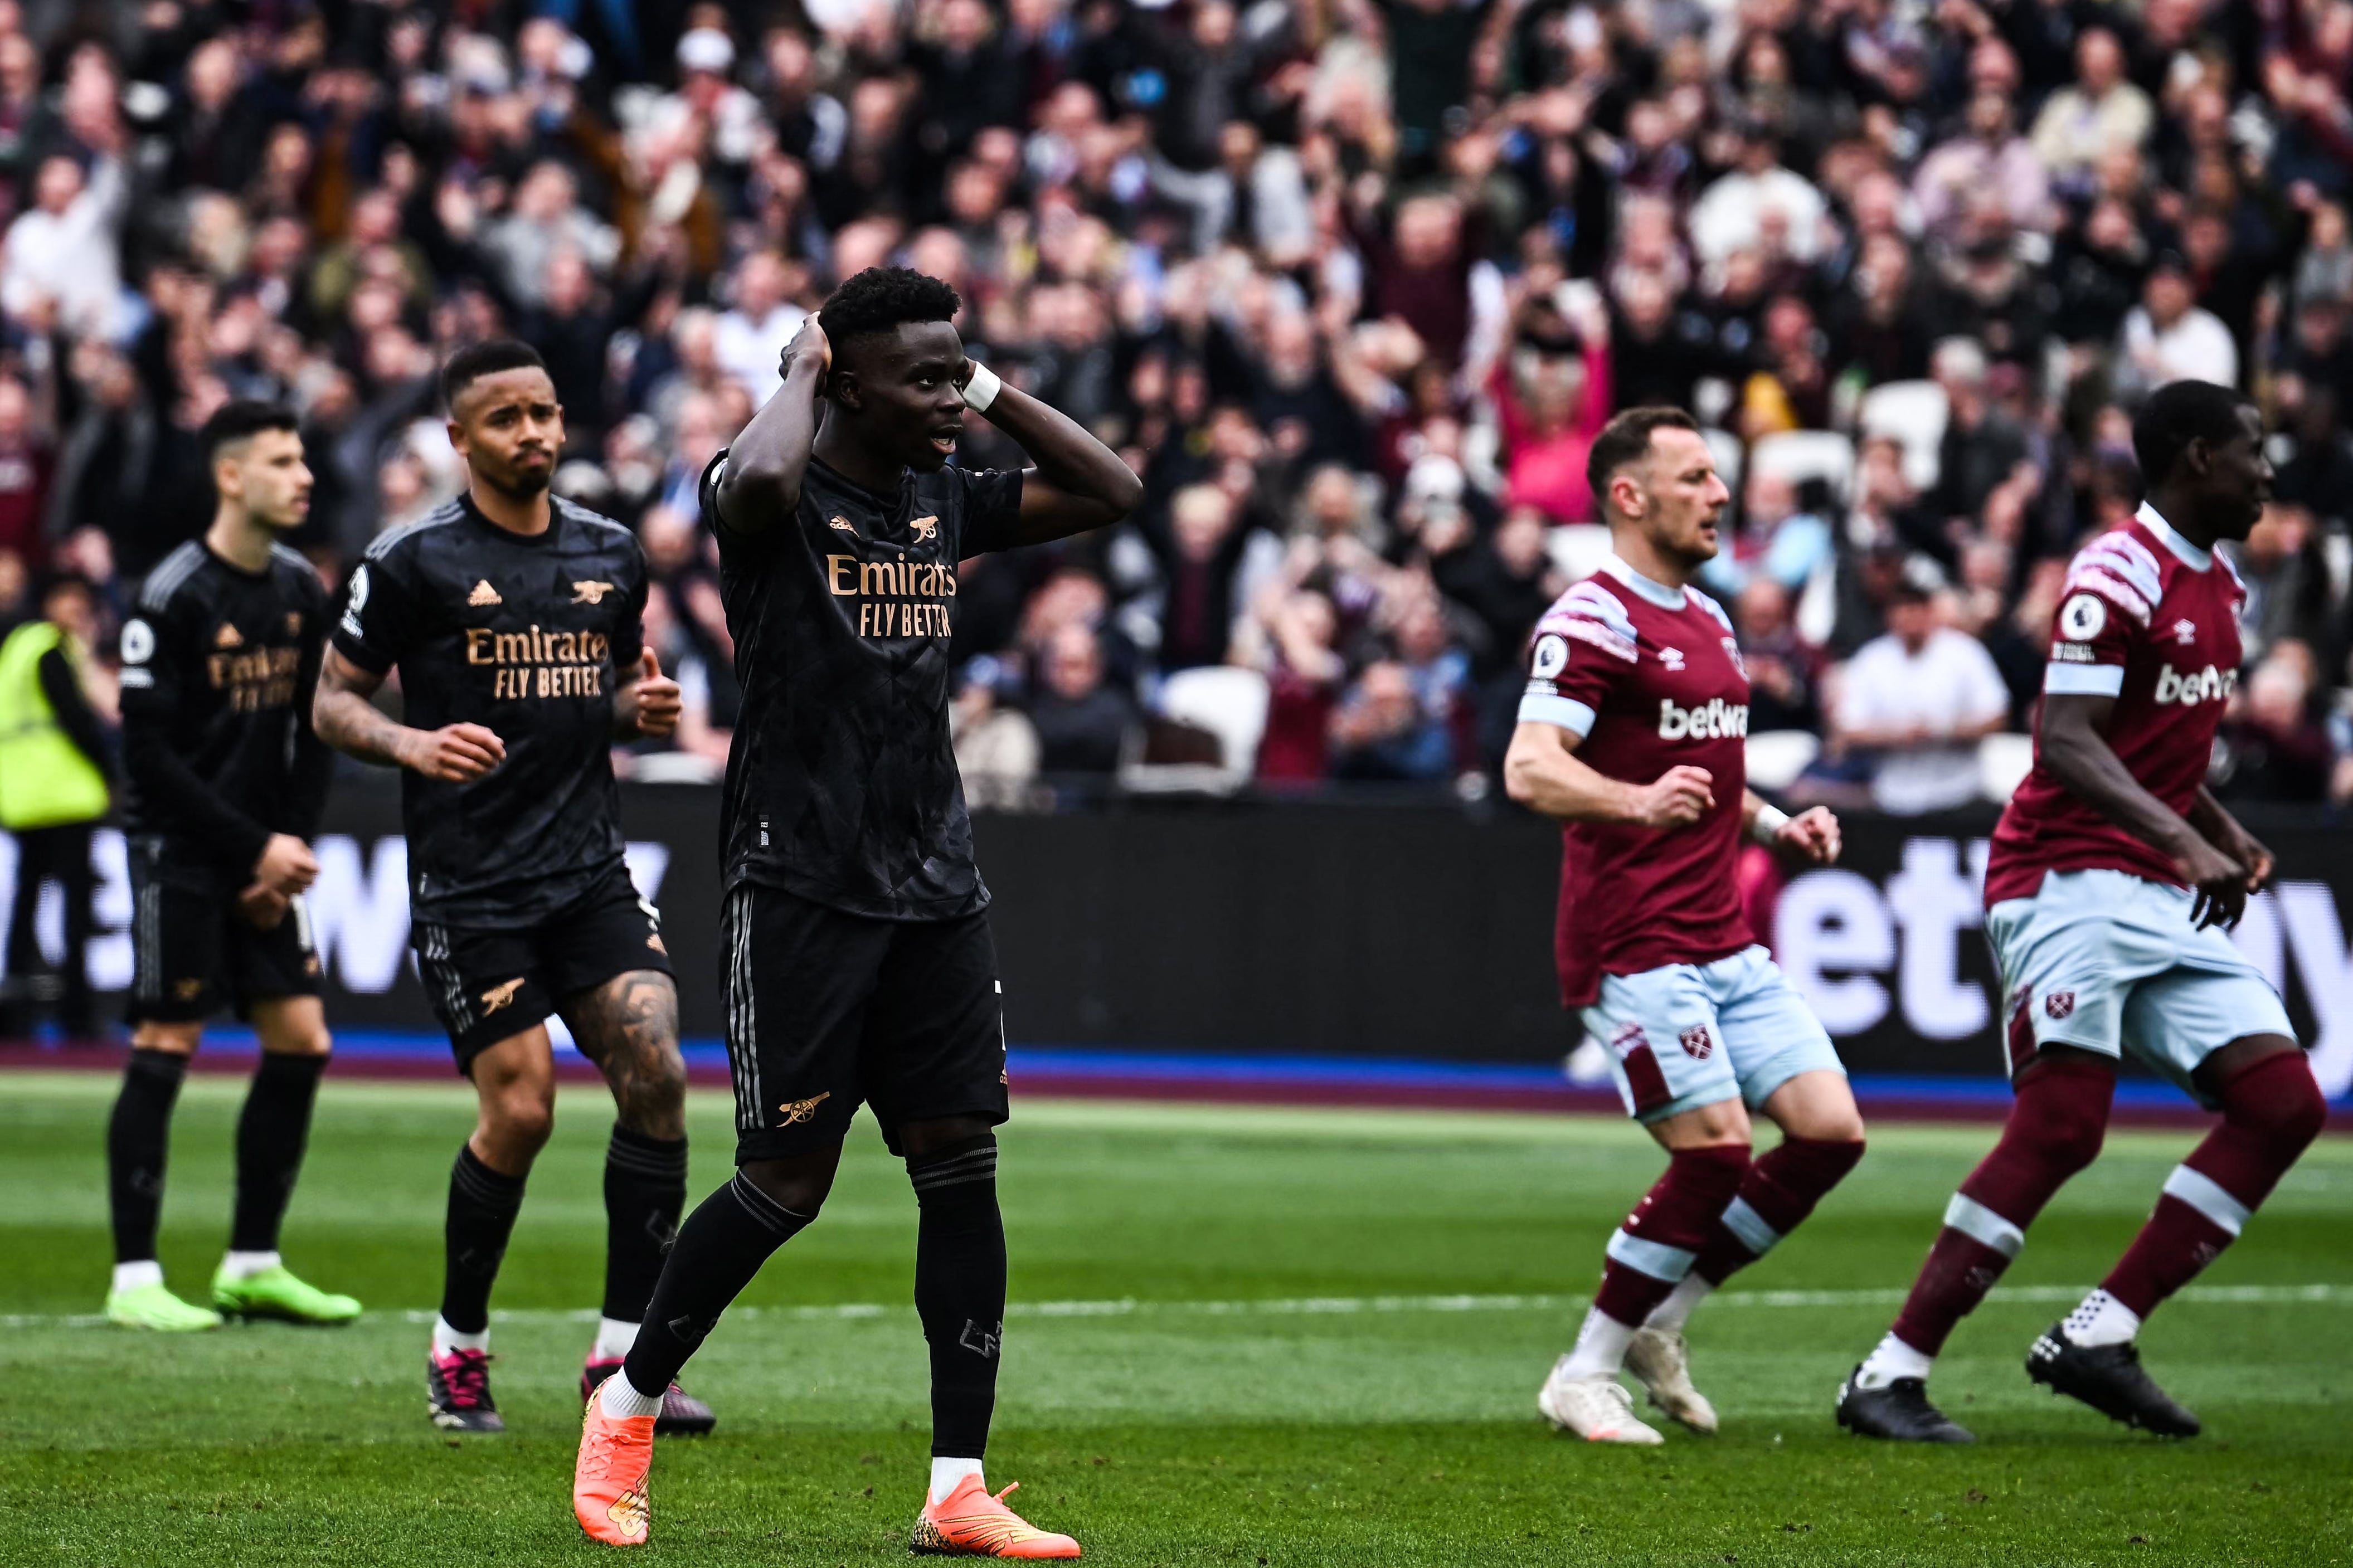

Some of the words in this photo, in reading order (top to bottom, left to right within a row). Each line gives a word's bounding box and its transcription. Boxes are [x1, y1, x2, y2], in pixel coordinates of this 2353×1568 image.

[825, 552, 956, 597] Emirats
[860, 603, 896, 637] FLY
[465, 624, 609, 665] Emirate
[494, 667, 530, 700] FLY
[1659, 697, 1749, 741] betwa
